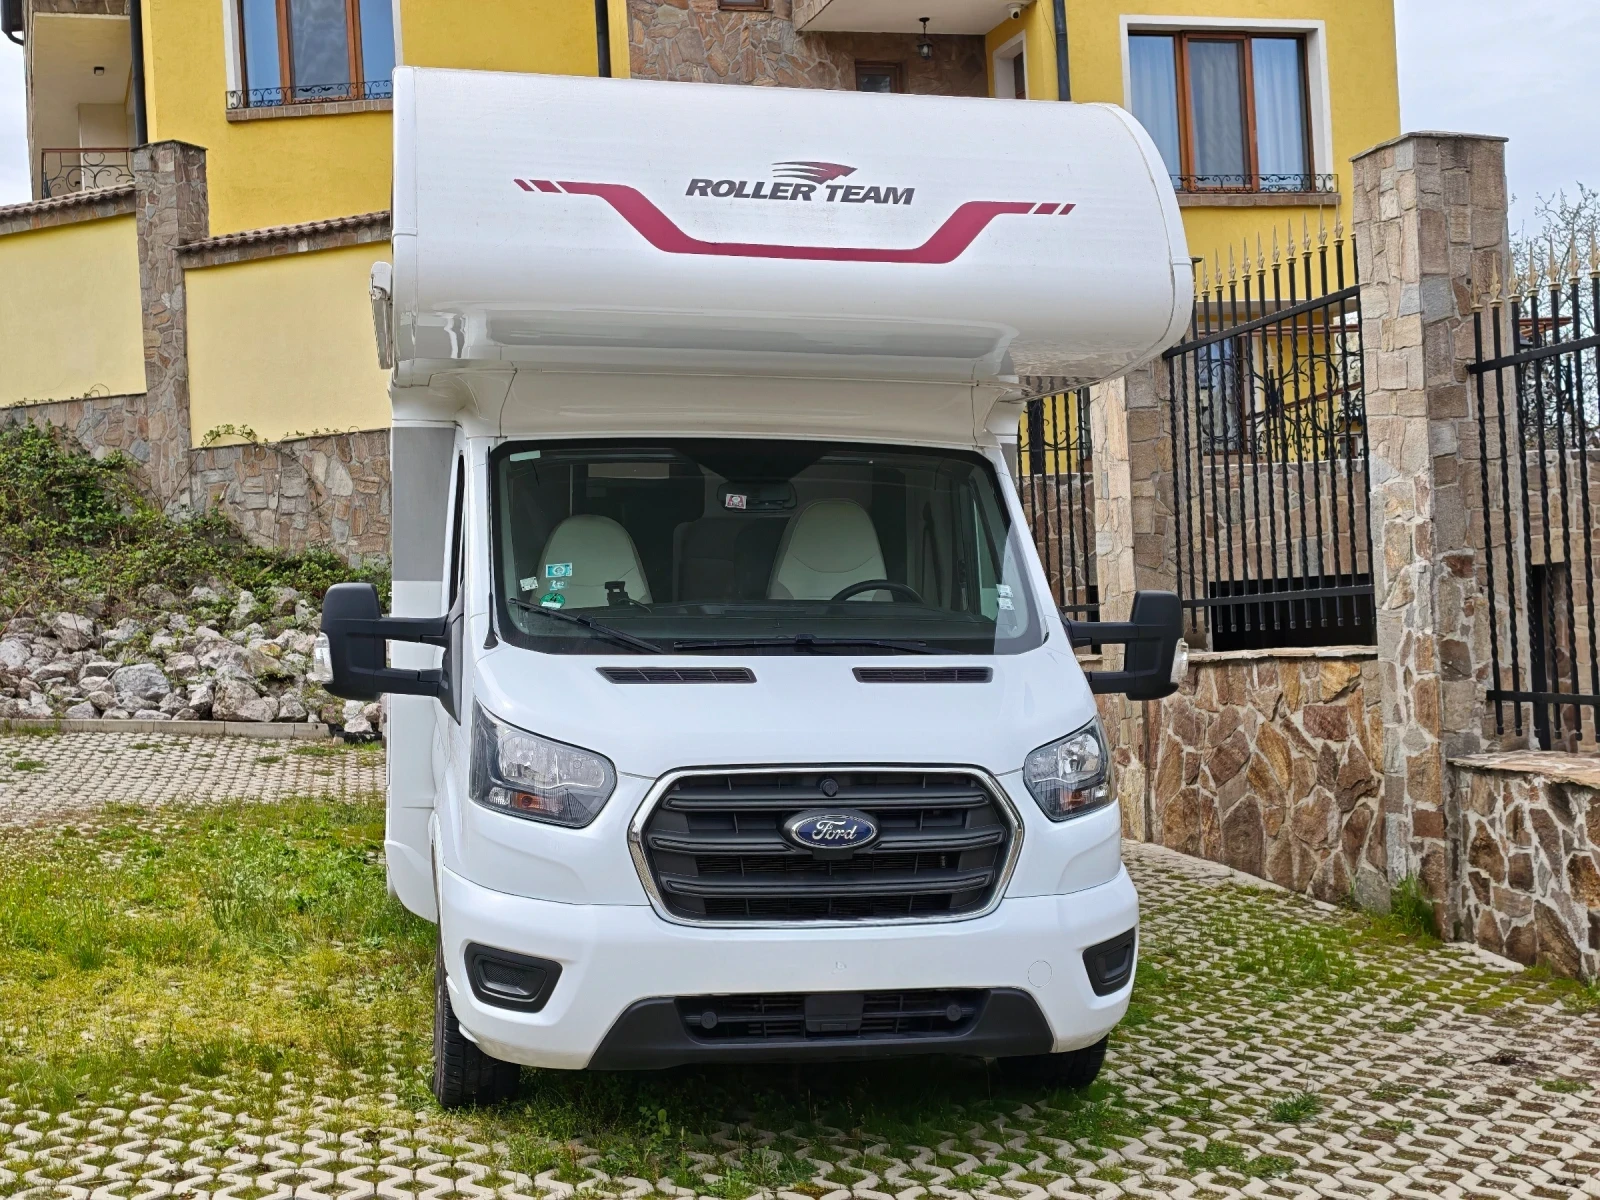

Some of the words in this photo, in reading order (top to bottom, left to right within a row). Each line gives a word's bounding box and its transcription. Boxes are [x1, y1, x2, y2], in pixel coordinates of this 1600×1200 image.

[685, 178, 817, 201] ROLLER
[825, 184, 915, 205] TEAM
[812, 820, 857, 840] Ford
